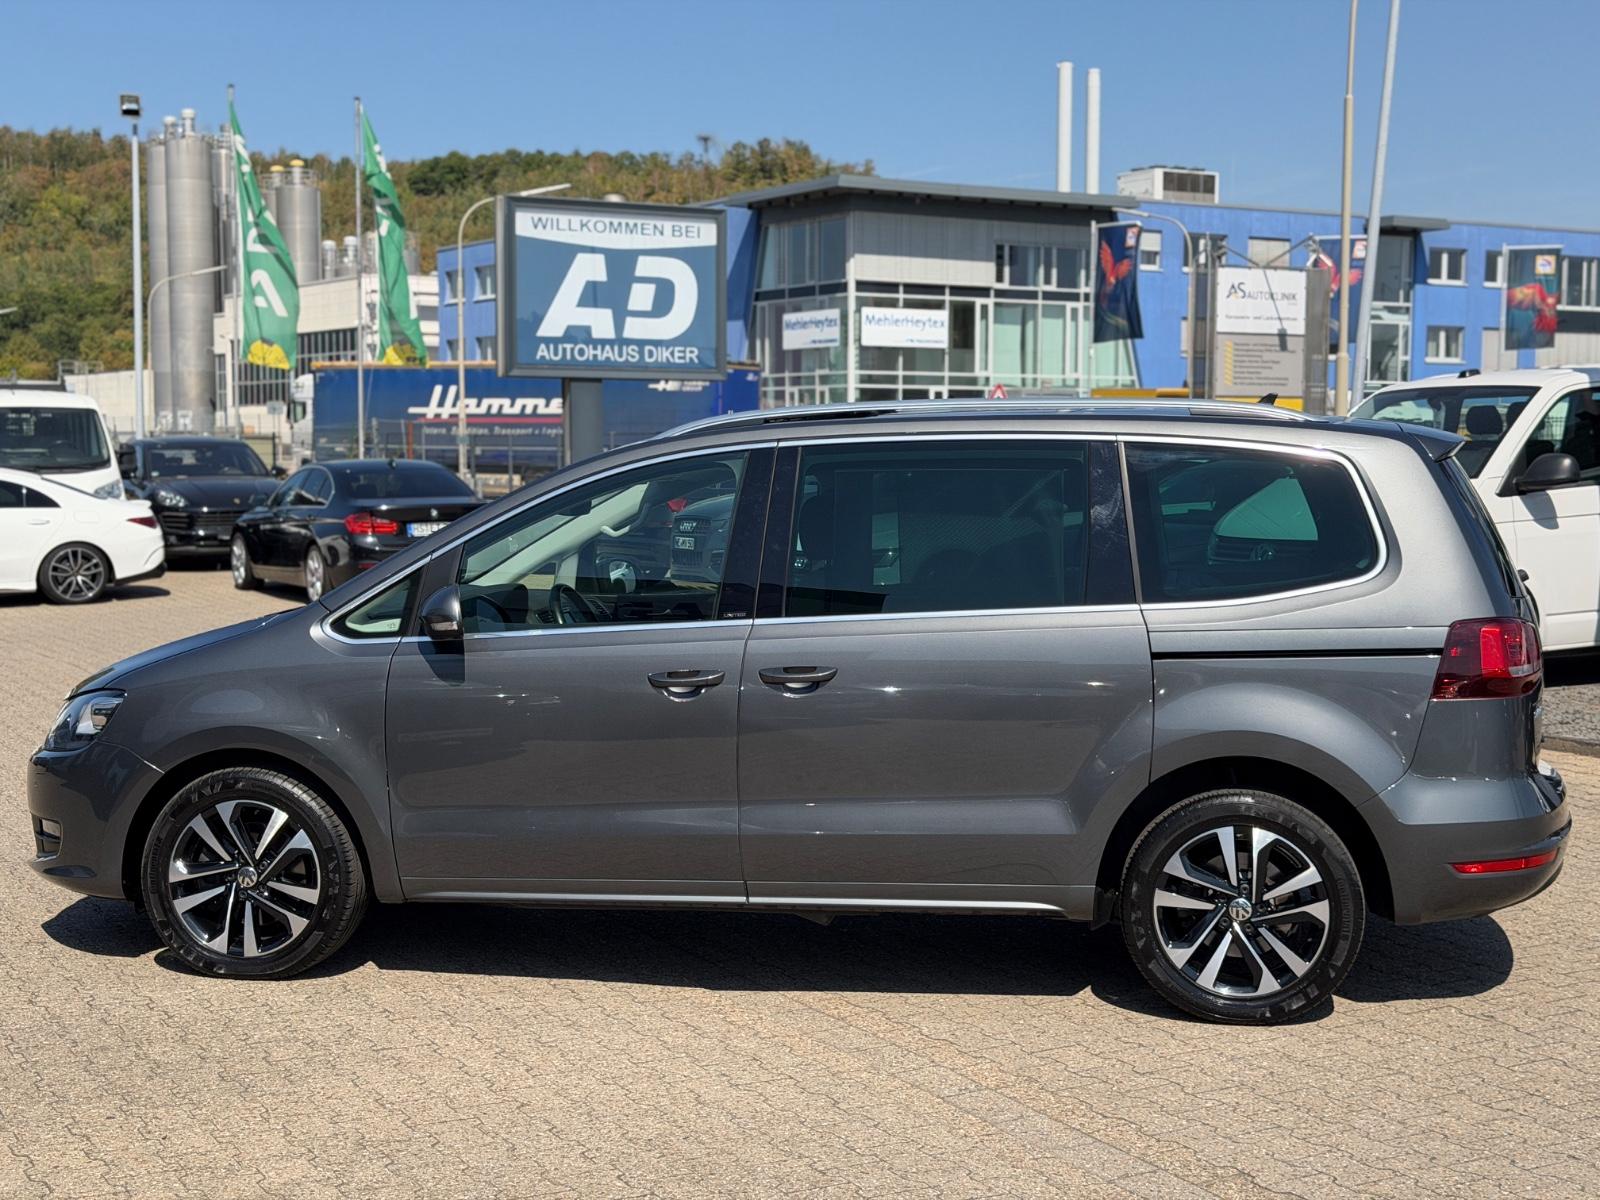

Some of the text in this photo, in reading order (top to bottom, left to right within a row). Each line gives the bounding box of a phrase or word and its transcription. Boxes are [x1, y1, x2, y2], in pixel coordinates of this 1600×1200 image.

[531, 216, 700, 239] WILLKOMMEN BEI
[535, 253, 698, 340] AD
[864, 314, 945, 332] MehlerHeytex
[535, 343, 699, 364] AUTOHAUS DIKER
